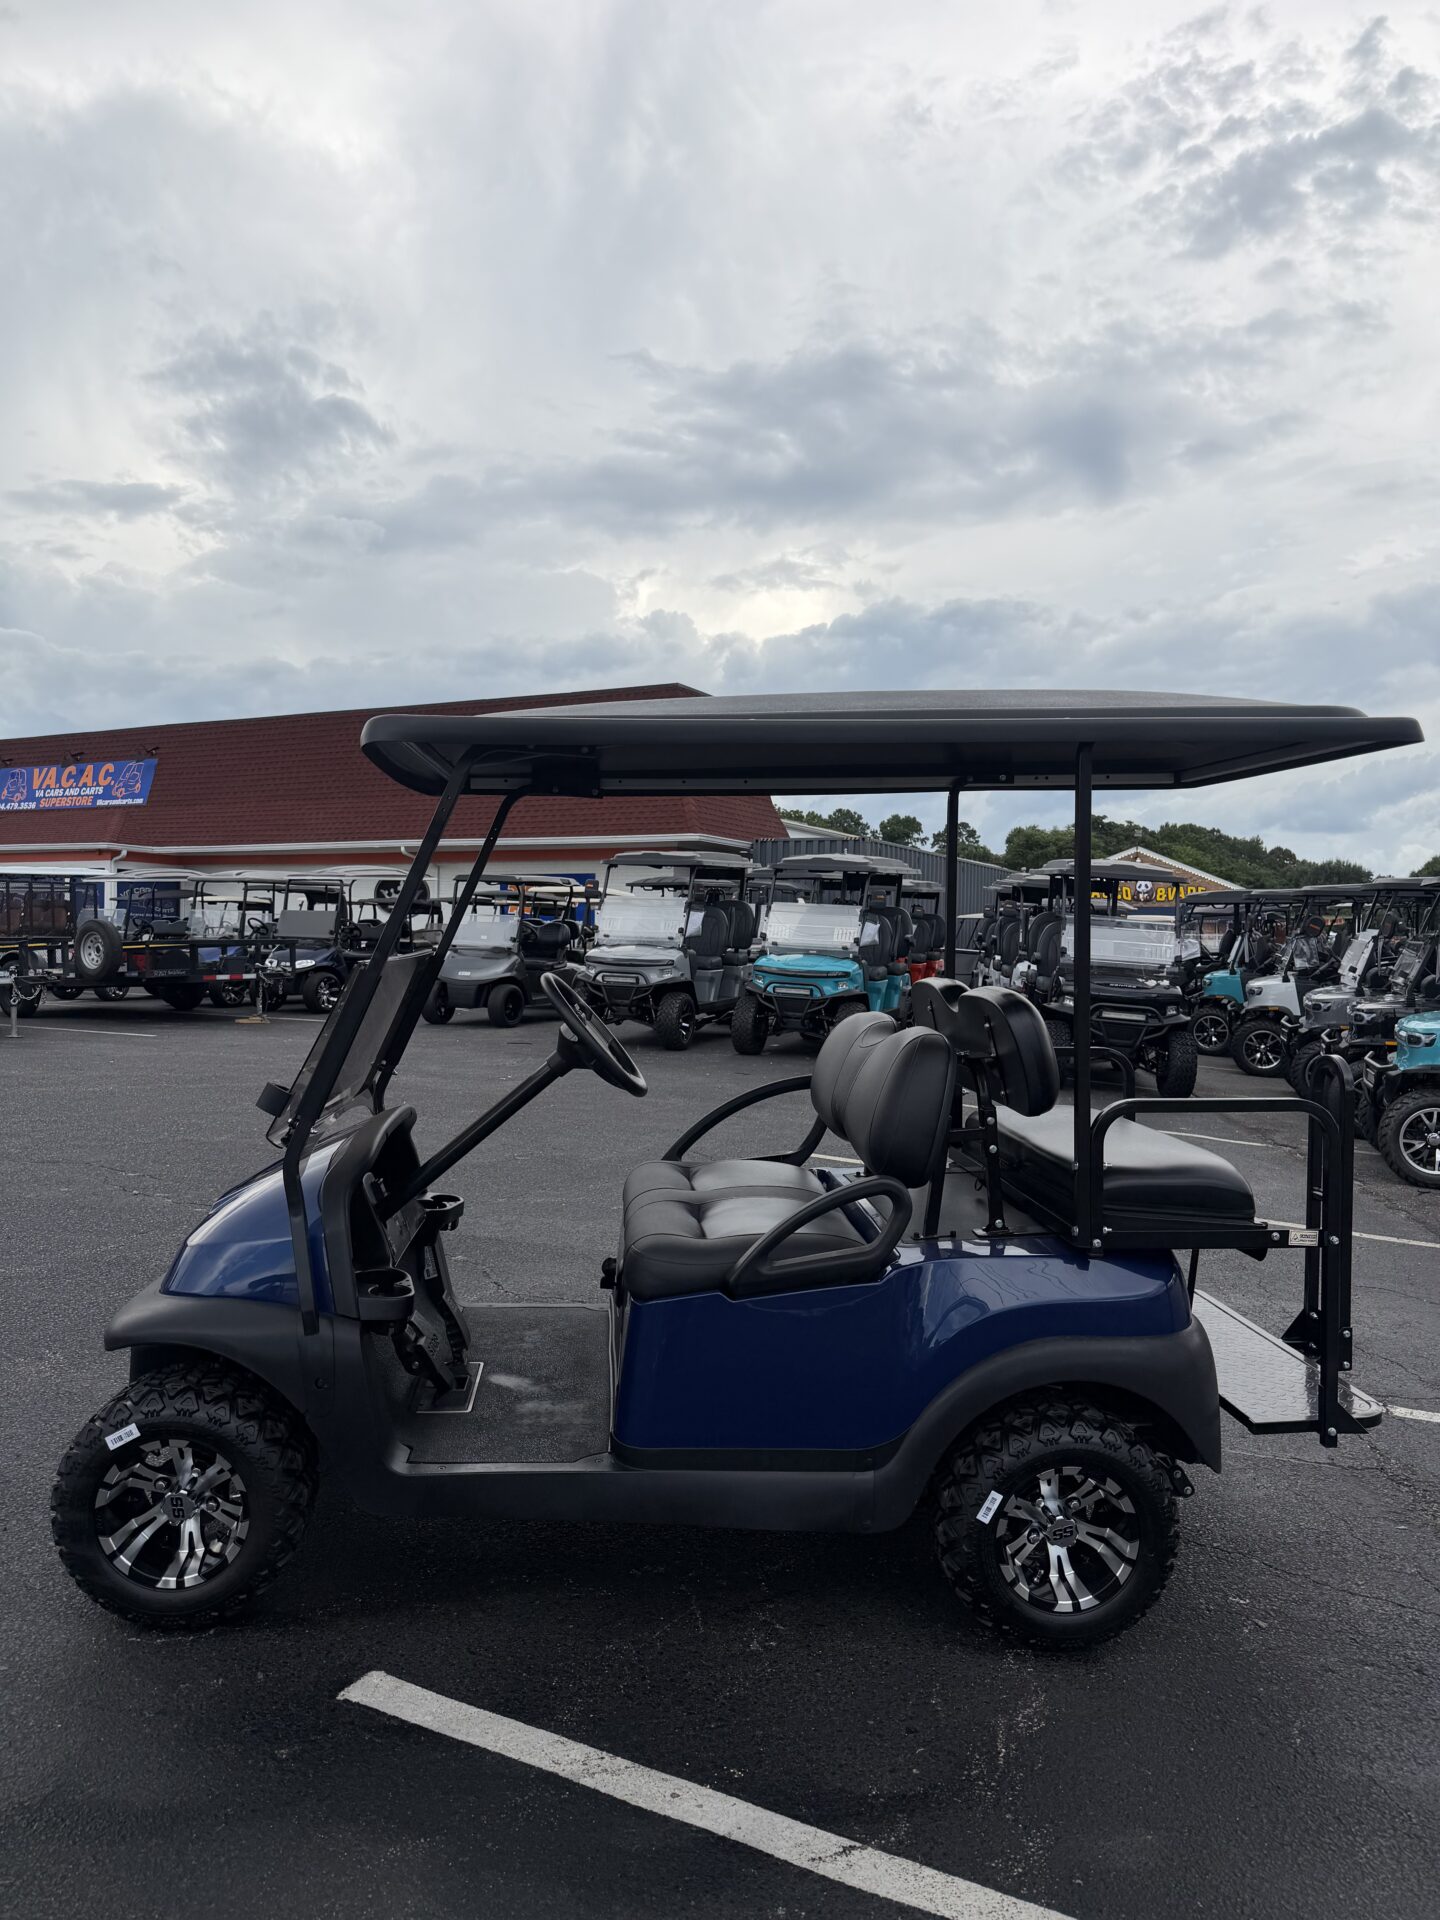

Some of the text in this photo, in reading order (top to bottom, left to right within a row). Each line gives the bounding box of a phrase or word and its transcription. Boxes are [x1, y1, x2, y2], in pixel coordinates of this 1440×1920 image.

[36, 786, 104, 798] VA CARS AND CARTS
[40, 796, 94, 808] SUPERSTORE
[1053, 1525, 1074, 1541] SS
